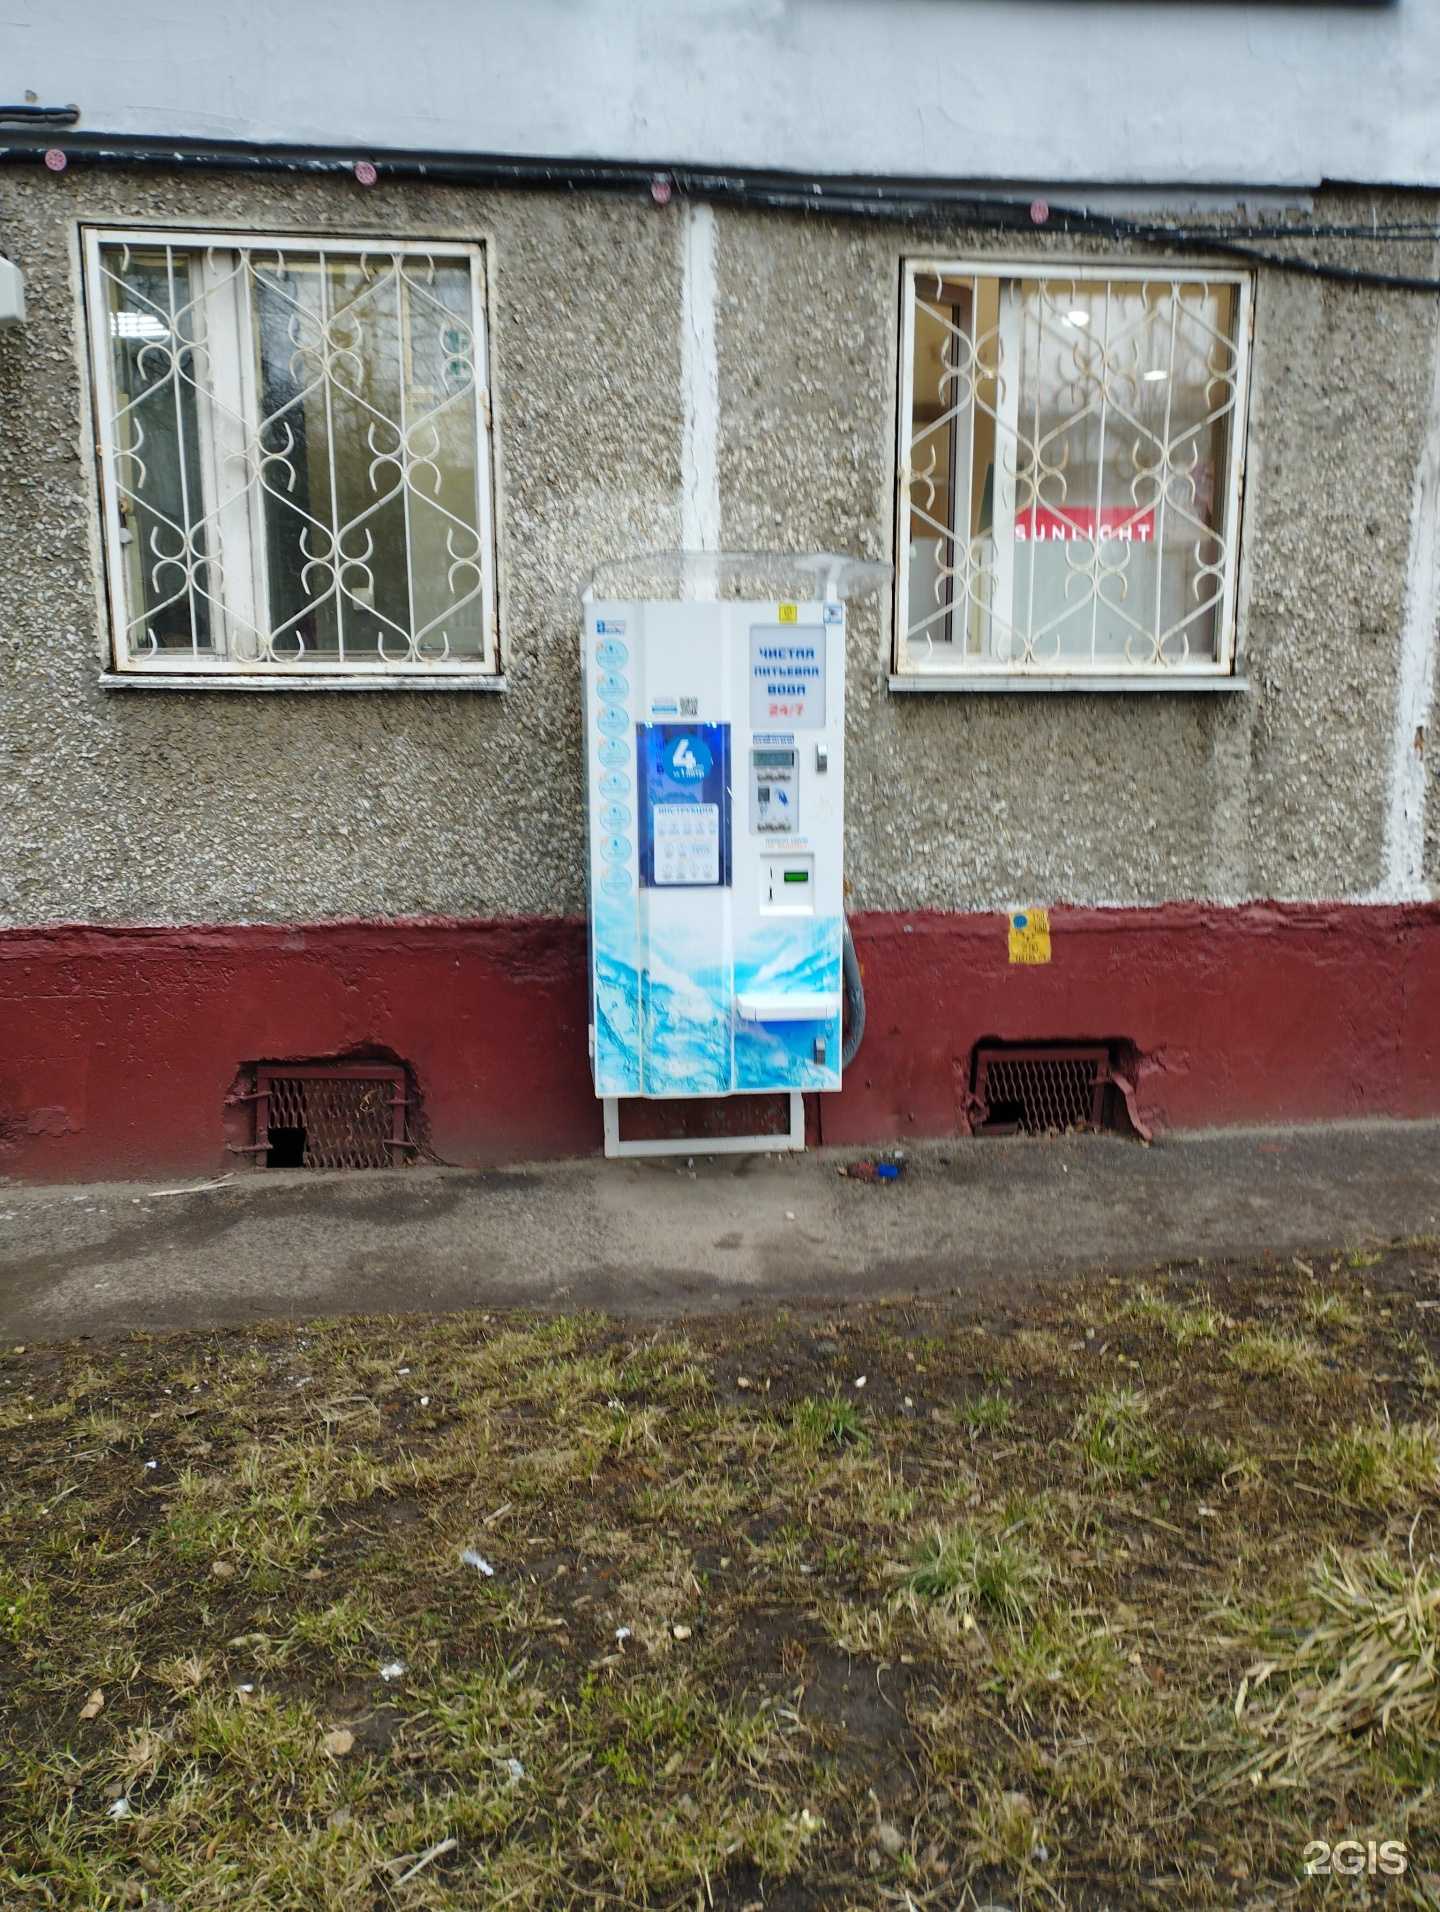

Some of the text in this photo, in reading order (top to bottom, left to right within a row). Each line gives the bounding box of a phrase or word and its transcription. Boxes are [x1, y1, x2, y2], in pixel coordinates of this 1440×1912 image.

[758, 647, 815, 660] ЧИСТАЯ
[754, 666, 820, 678] ПИТЬЕВАЯ
[767, 683, 806, 696] ВОДА
[769, 703, 805, 717] 24/7
